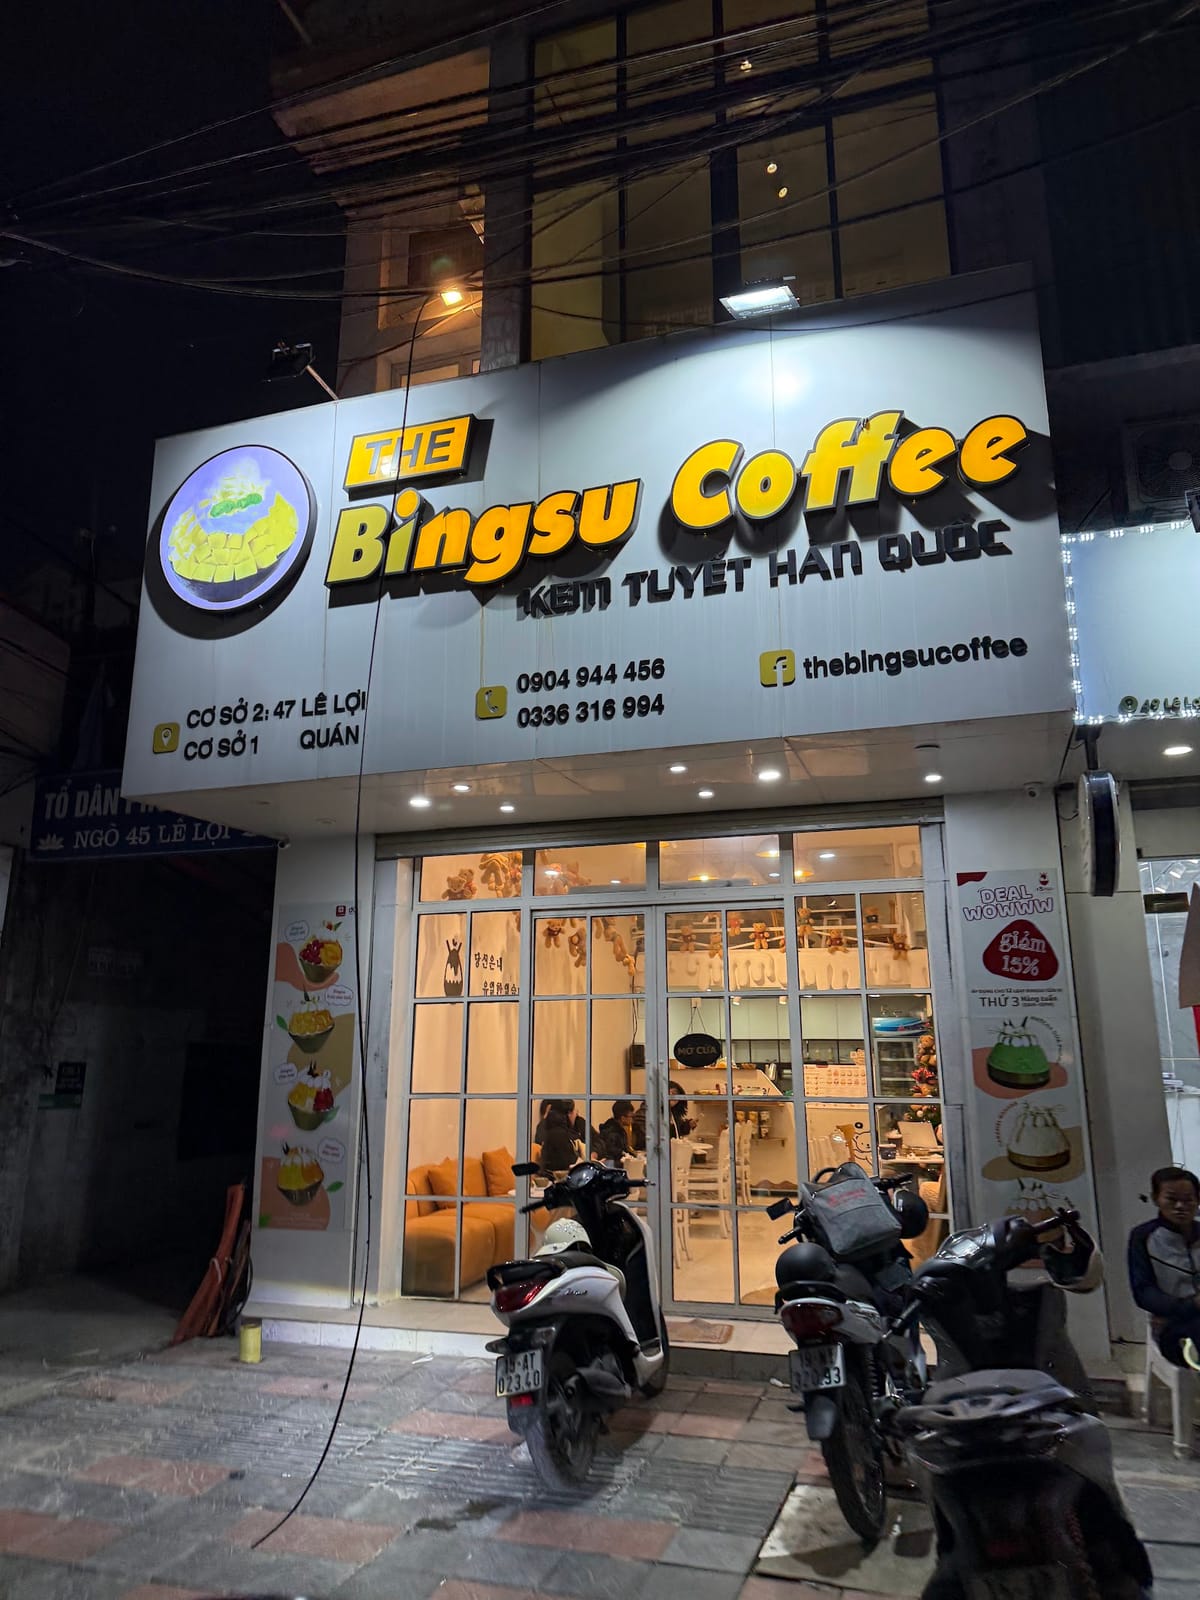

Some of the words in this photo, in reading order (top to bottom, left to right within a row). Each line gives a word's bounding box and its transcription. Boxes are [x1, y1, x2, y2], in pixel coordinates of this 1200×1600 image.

[364, 427, 457, 474] THE
[325, 478, 644, 587] Bingsu
[671, 410, 1031, 530] Coffee
[803, 635, 1029, 679] thebingsucoffee
[516, 669, 570, 694] 0904
[575, 663, 617, 687] 944
[623, 658, 666, 682] 456
[186, 705, 216, 729] CƠ
[219, 697, 249, 726] SỞ
[273, 700, 296, 719] 47
[301, 692, 328, 717] LÊ
[333, 689, 367, 716] LỢI
[517, 703, 570, 728] 0336
[575, 698, 616, 723] 316
[622, 693, 665, 719] 994
[183, 737, 214, 761] CƠ
[217, 729, 247, 758] SỞ
[250, 735, 259, 754] 1
[299, 722, 360, 750] QUÁN
[74, 783, 120, 817] DÂN
[125, 826, 151, 845] 45
[159, 817, 187, 843] LÊ
[963, 897, 1054, 921] WOWWW
[979, 885, 1033, 904] DEAL
[1001, 955, 1040, 976] 15%
[979, 993, 1010, 1007] THỨ
[1011, 997, 1020, 1007] 3
